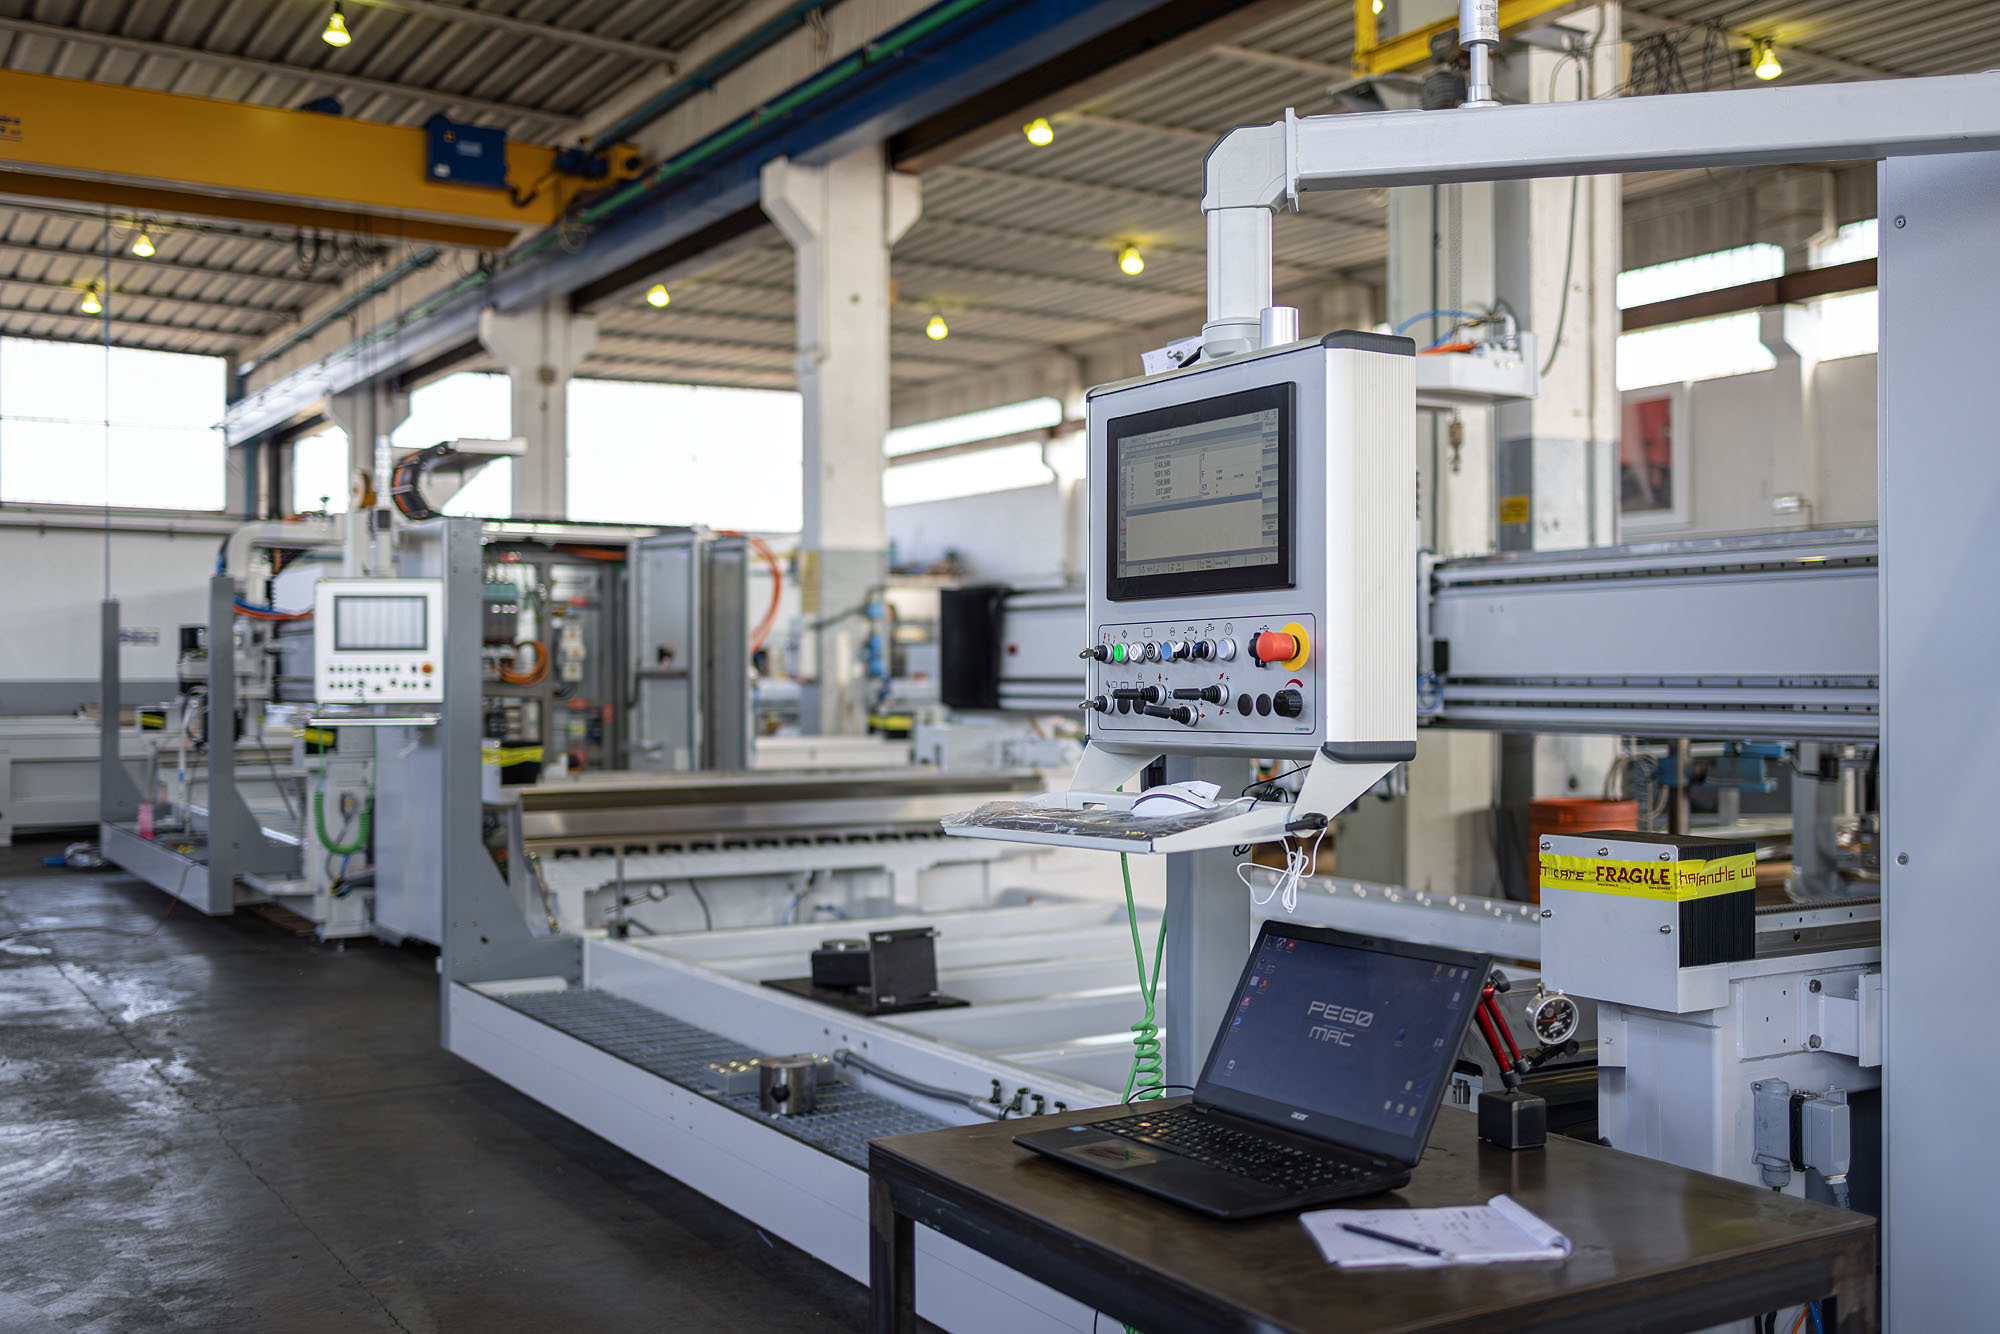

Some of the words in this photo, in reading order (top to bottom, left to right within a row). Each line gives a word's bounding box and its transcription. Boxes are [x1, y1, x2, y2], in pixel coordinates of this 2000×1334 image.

[1595, 865, 1671, 886] FRAGILE
[1309, 1026, 1355, 1047] MAC
[1290, 1111, 1309, 1121] acer
